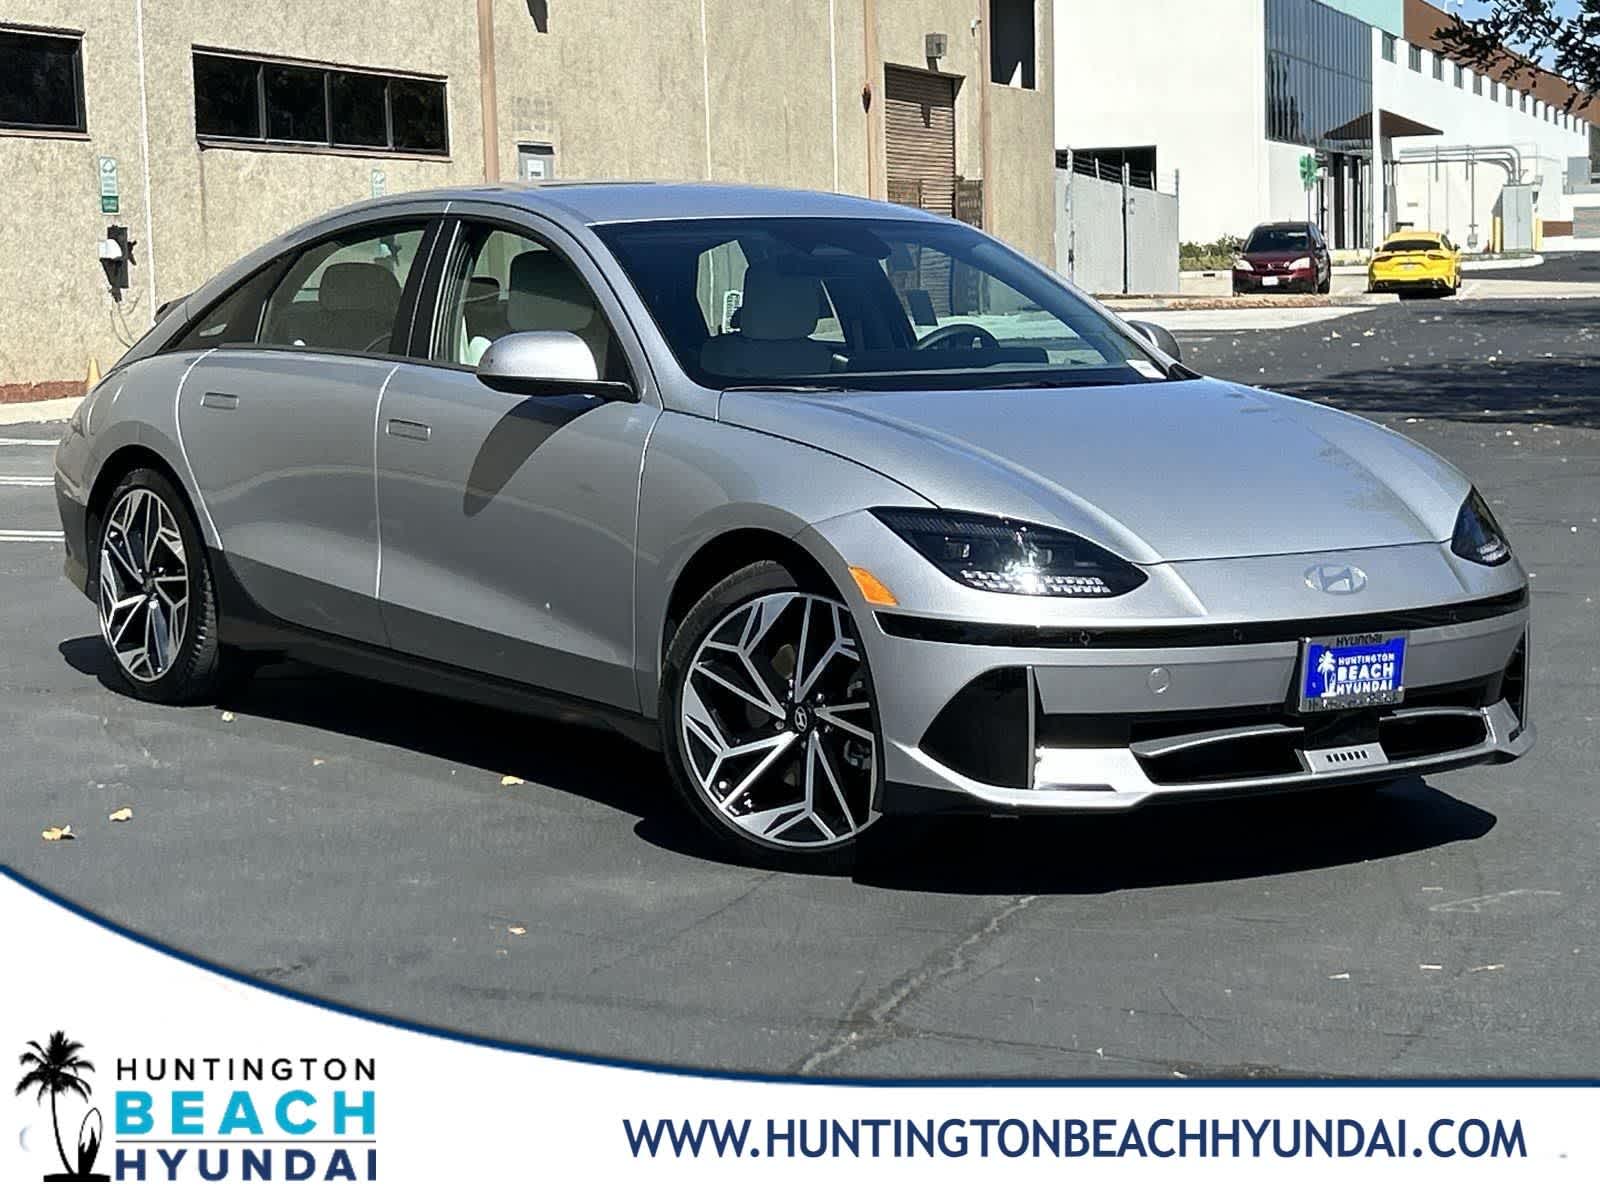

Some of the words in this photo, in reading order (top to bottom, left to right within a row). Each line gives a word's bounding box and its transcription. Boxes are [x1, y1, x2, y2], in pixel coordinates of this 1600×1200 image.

[1338, 653, 1395, 665] HUNTINGTON
[1337, 662, 1394, 681] BEACH
[1336, 680, 1393, 695] HYUNDAI
